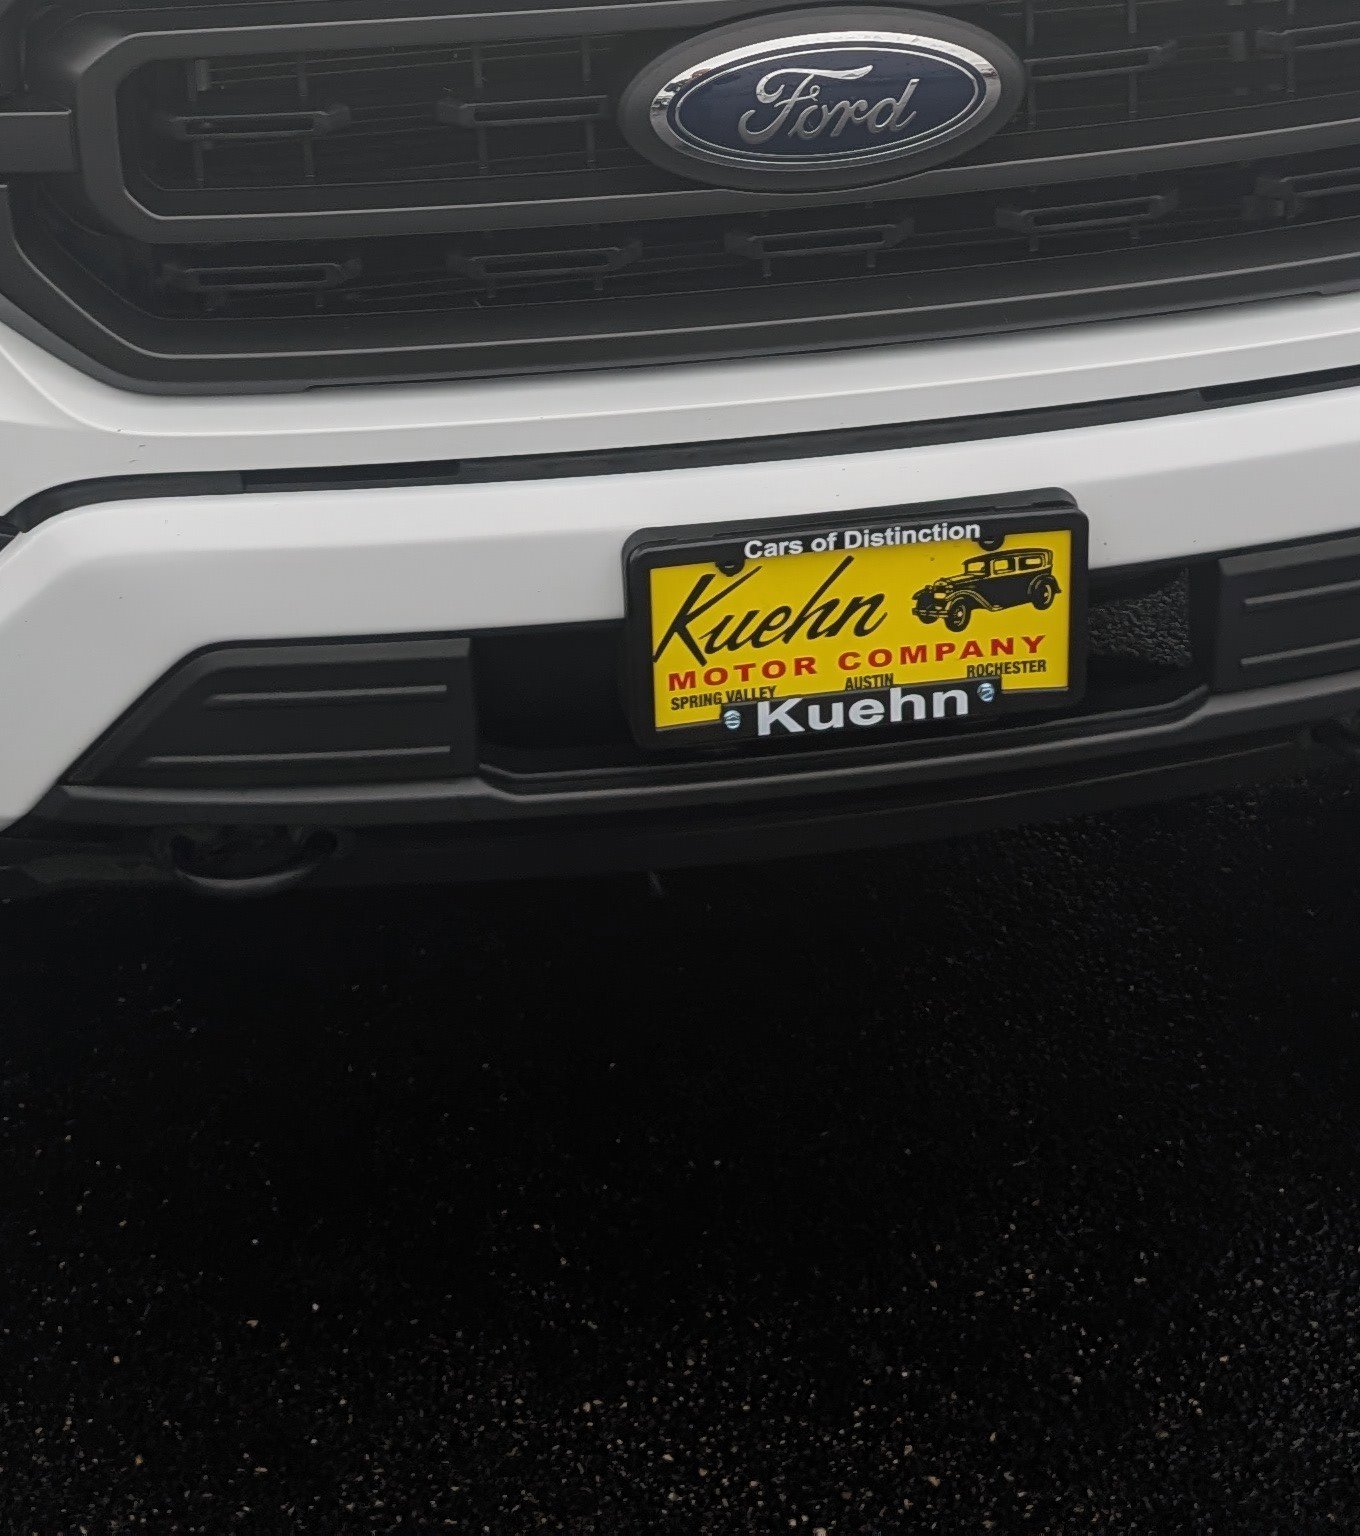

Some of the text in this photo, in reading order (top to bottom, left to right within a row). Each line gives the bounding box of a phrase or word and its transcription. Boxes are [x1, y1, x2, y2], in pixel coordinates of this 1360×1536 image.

[737, 64, 920, 145] Ford
[744, 522, 981, 560] Cars of Distinction
[652, 554, 889, 668] Kuehn
[668, 634, 1047, 692] MOTOR COMPANY
[670, 659, 1047, 711] SPRING VALLEY AUSTIN ROCHESTER
[757, 685, 970, 737] Kuehn
